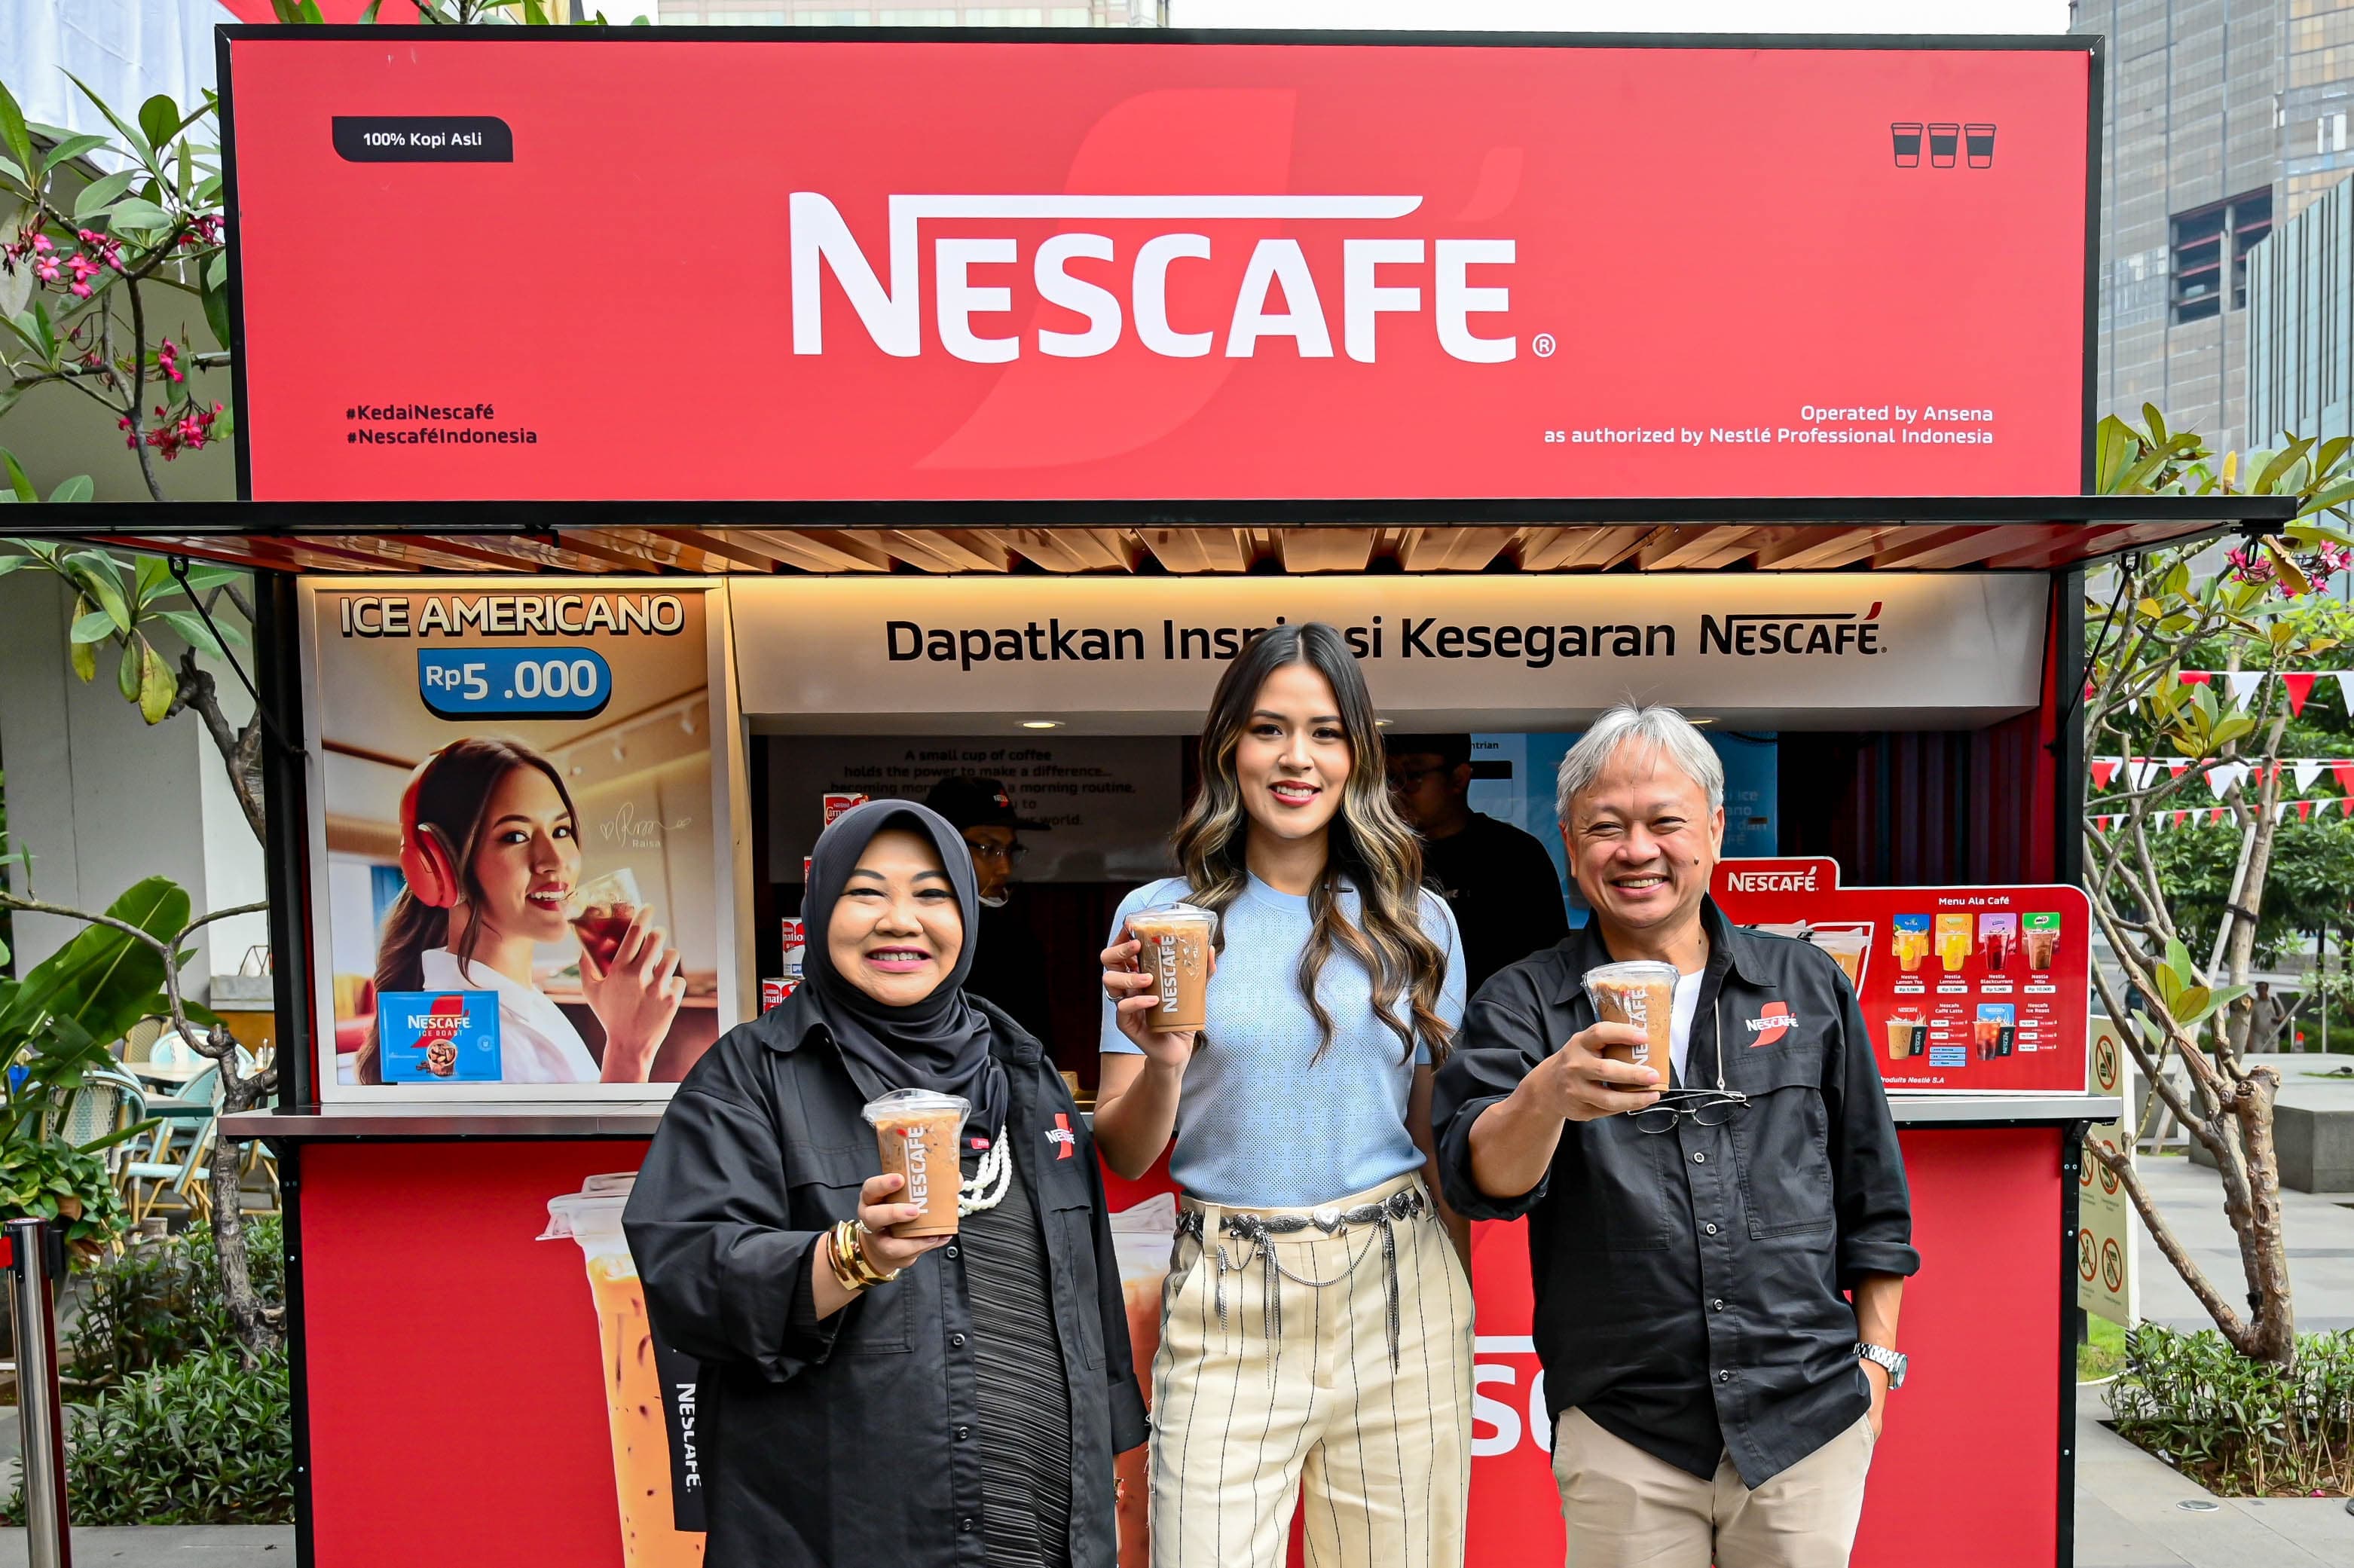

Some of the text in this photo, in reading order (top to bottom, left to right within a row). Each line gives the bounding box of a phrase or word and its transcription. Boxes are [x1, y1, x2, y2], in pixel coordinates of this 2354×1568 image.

[362, 131, 482, 149] 100% Kopi Asli
[346, 403, 494, 421] #KedaiNescafé
[1800, 405, 1993, 425] Operated by Ansena
[347, 427, 537, 445] #NescaféIndonesia
[1543, 427, 1993, 448] as authorized by Nestlé Professional Indonesia
[340, 594, 684, 637] ICE AMERICANO
[885, 617, 1145, 672] Dapatkan
[1163, 616, 1383, 661] Inssi
[1401, 617, 1675, 669] Kesegaran
[905, 750, 1051, 763] A small cup of coffee
[844, 766, 882, 777] holds
[887, 766, 909, 777] the
[914, 767, 957, 780] power
[980, 766, 1016, 777] make
[1021, 769, 1029, 777] a
[1020, 782, 1078, 796] morning
[1023, 799, 1036, 809] to
[1728, 866, 1817, 892] NESCAFÉ
[1968, 897, 1985, 905] Ala
[1987, 896, 2010, 905] Café
